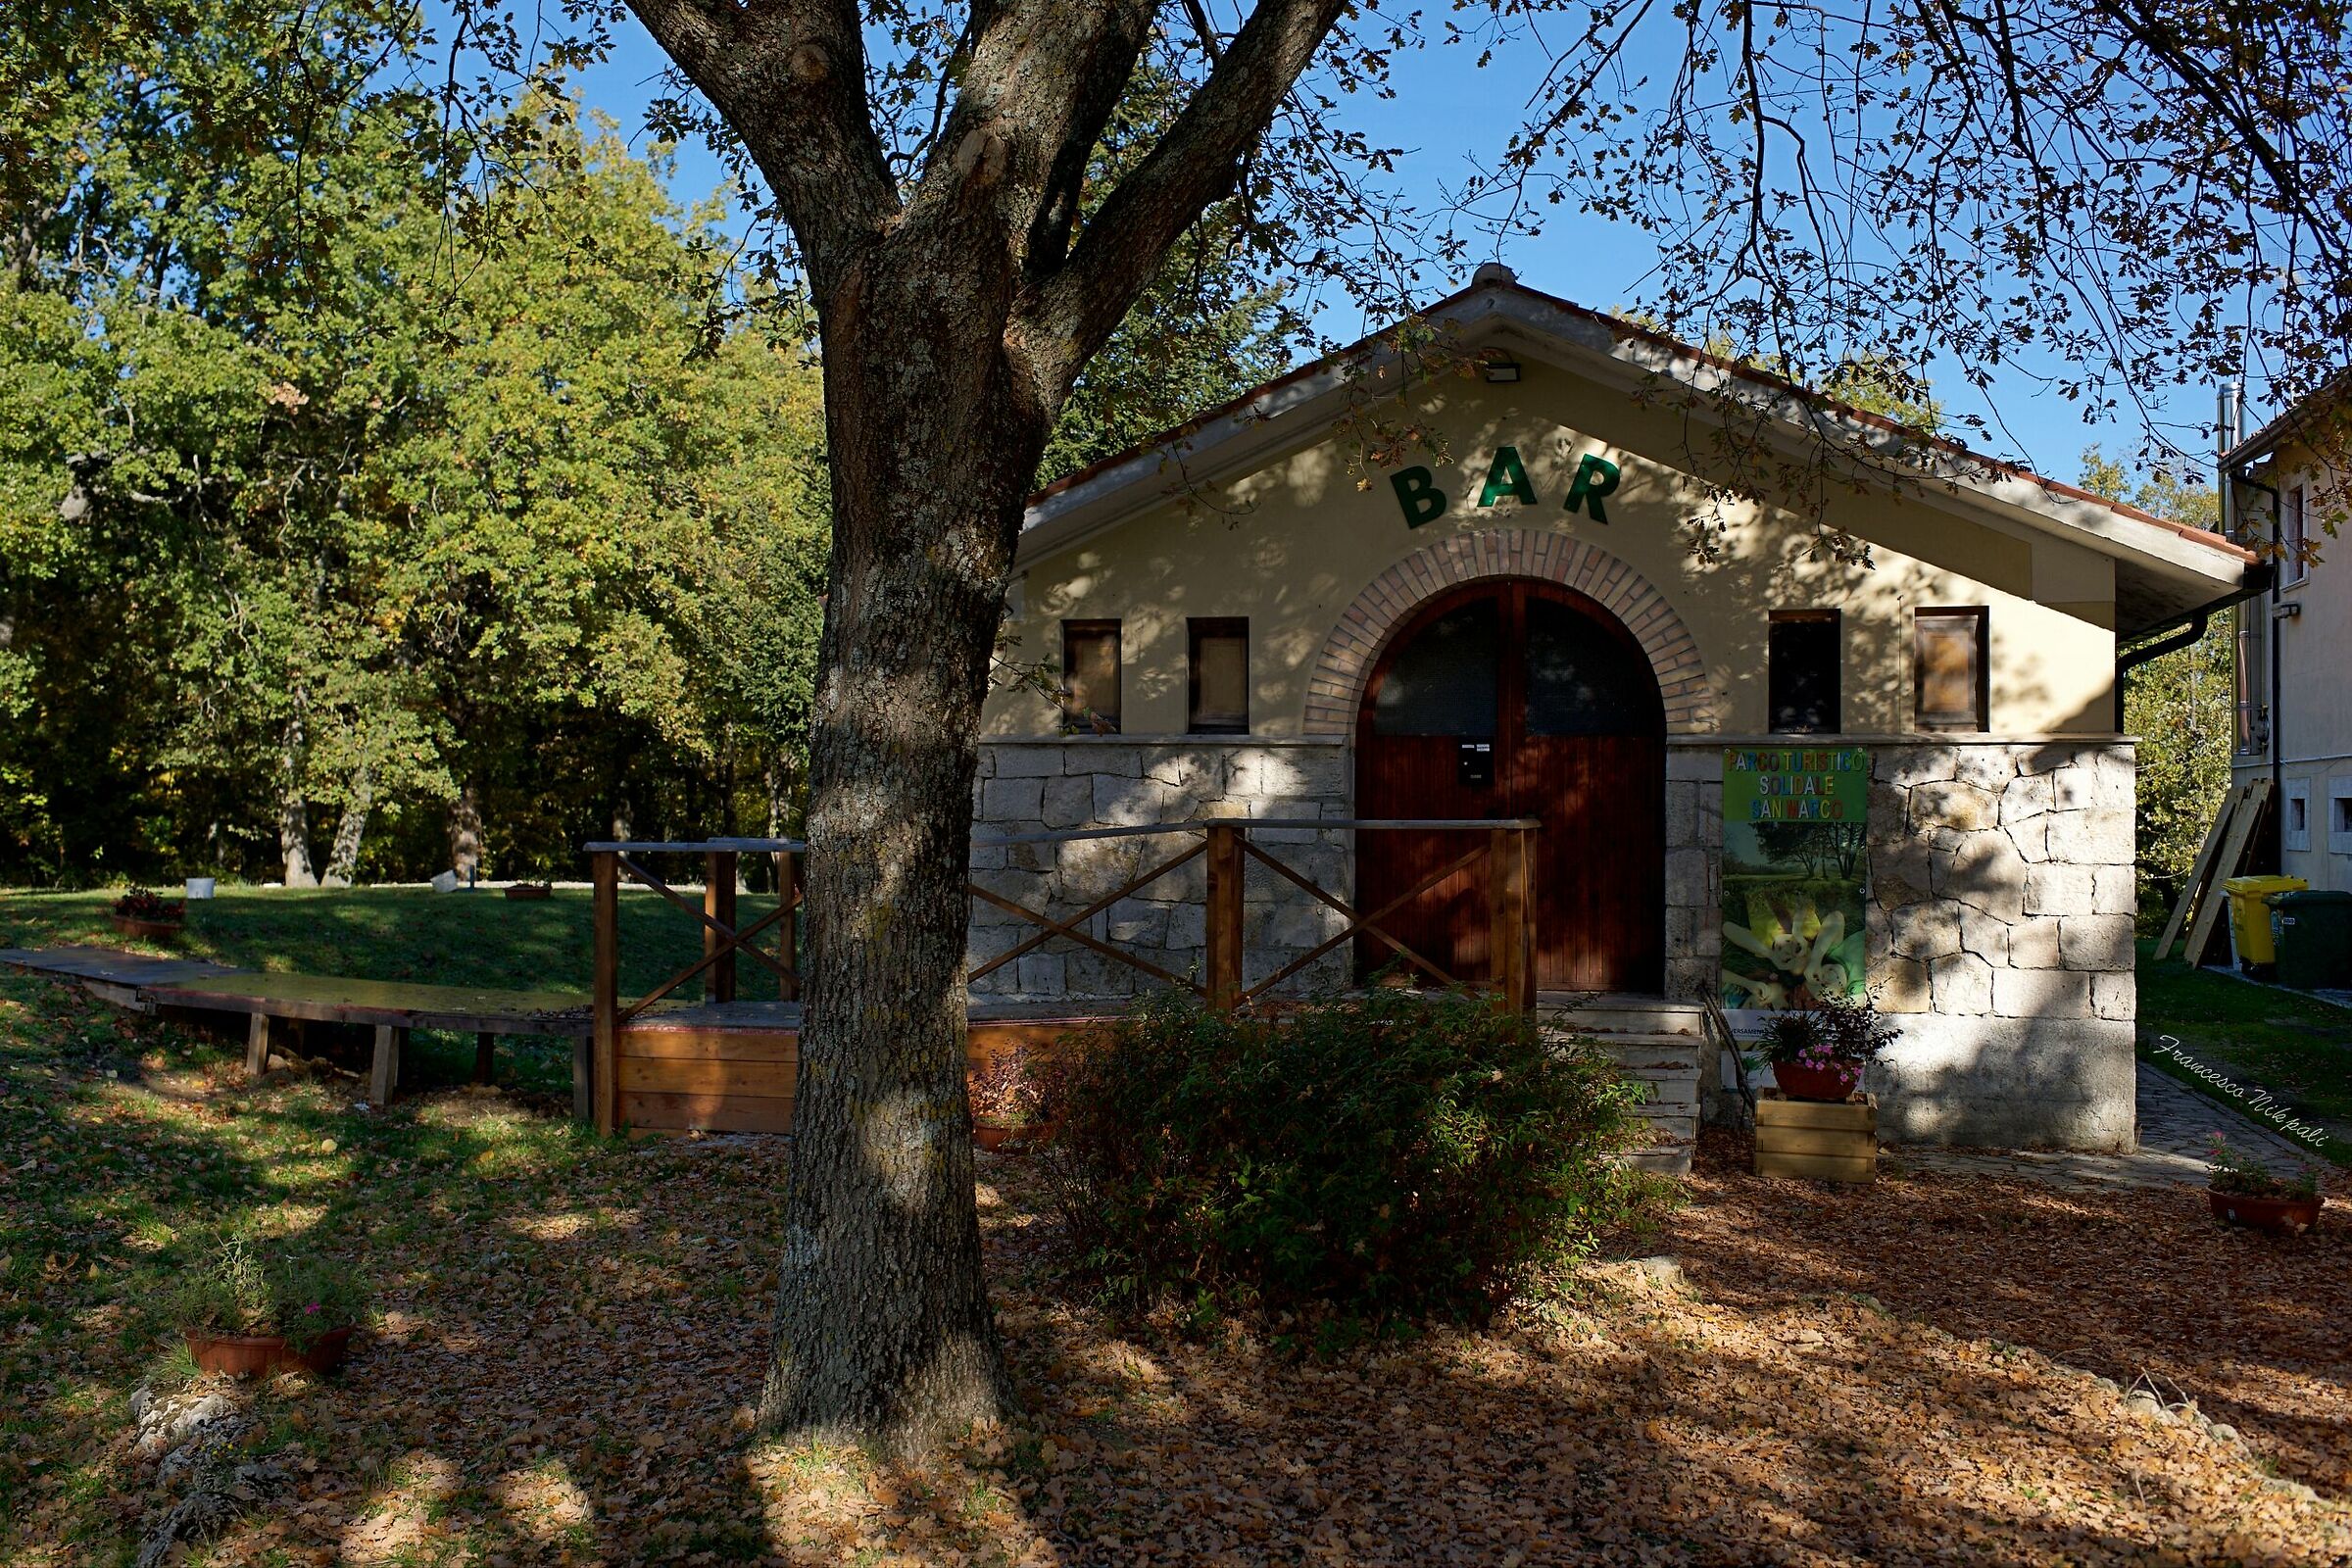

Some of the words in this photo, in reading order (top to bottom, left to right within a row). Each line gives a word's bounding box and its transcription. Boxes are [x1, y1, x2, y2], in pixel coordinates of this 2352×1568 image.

[1390, 447, 1621, 530] BAR
[1727, 752, 1780, 772] PARCO
[1784, 752, 1864, 772] TURISTICO
[1760, 776, 1834, 796] SOLIDALE
[1750, 799, 1782, 819] SAN
[1787, 799, 1843, 819] MARCO
